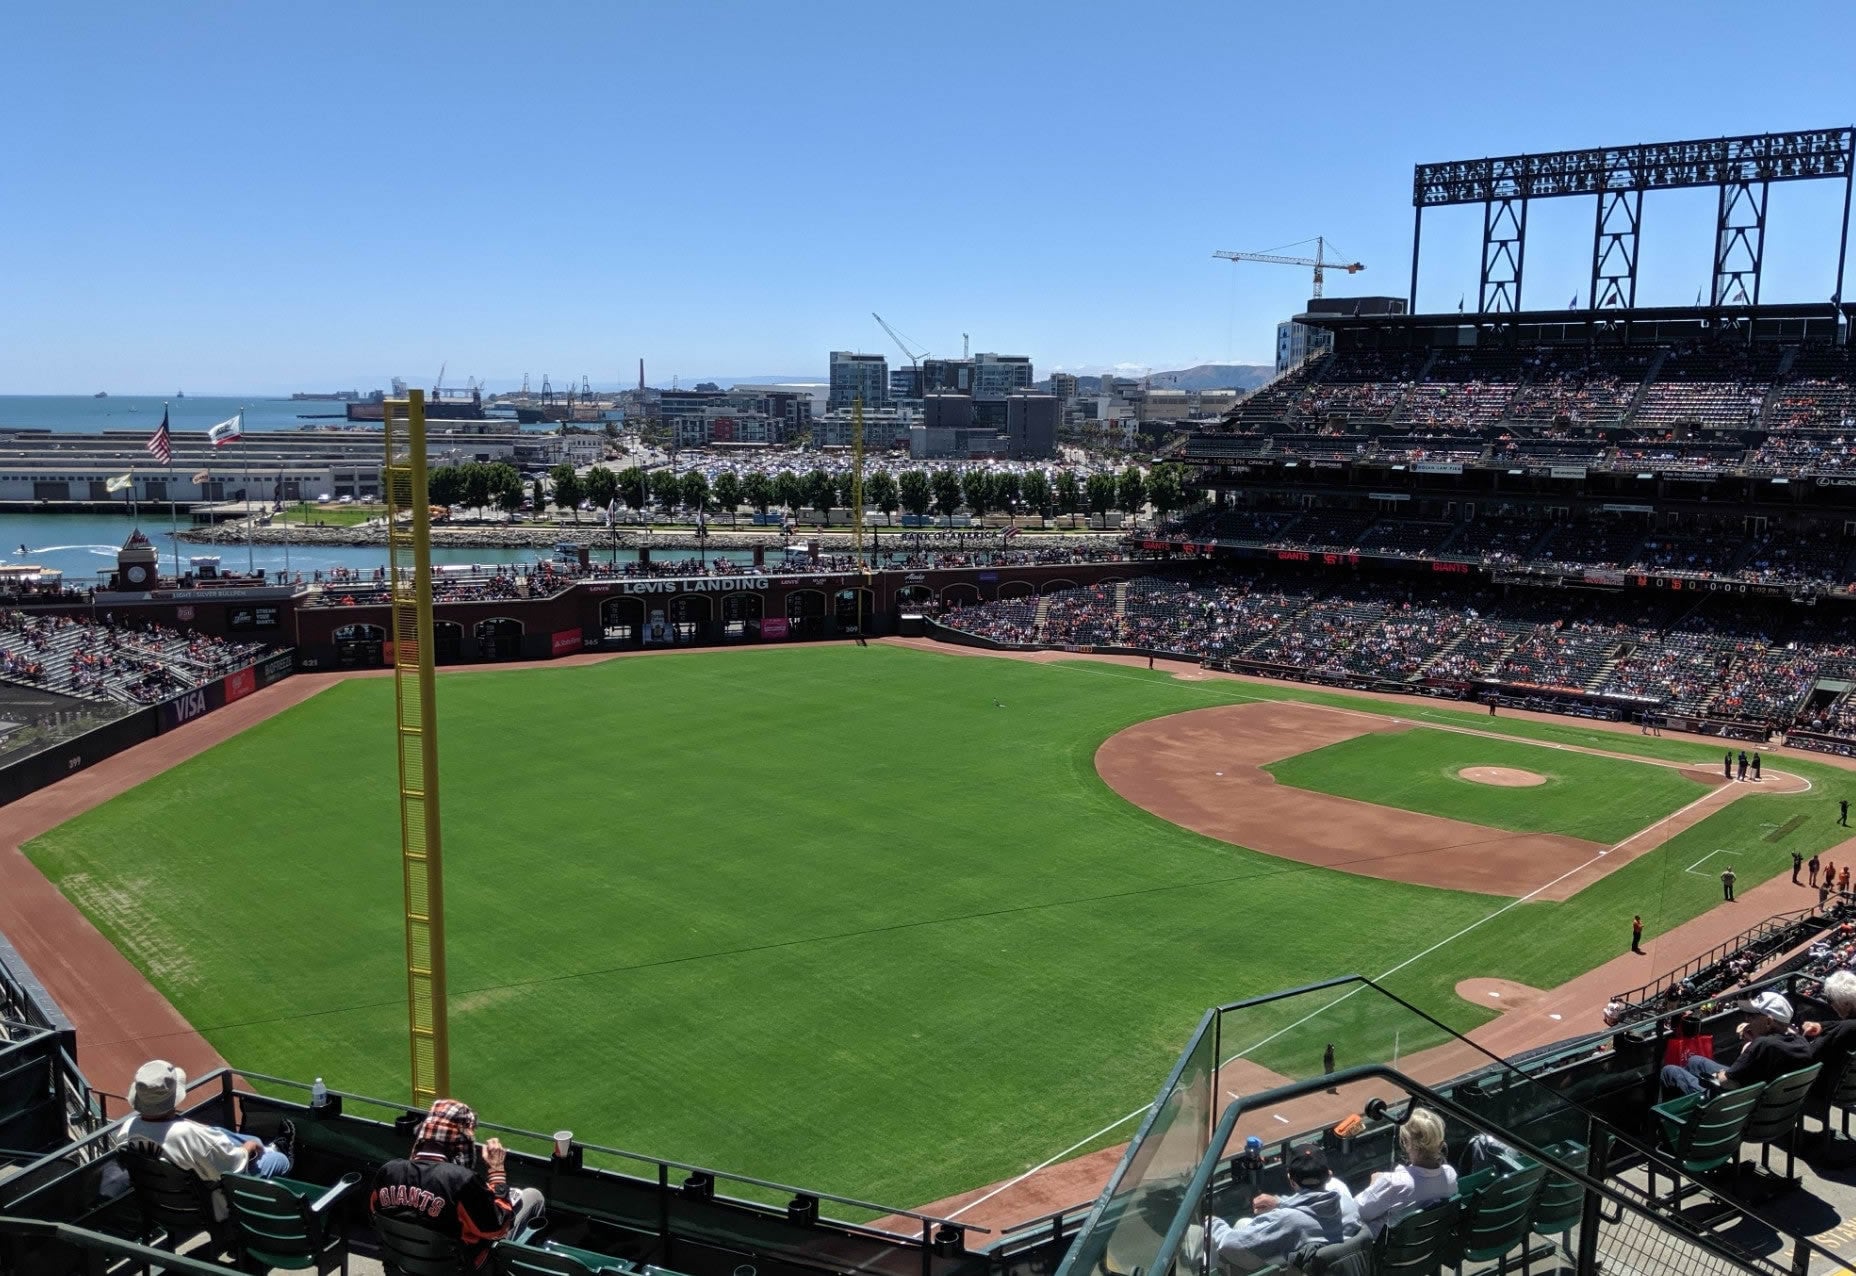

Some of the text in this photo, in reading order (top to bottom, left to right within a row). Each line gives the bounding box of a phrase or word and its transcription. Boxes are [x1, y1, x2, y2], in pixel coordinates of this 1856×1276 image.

[902, 530, 998, 540] BANK OF AMERICA
[1143, 542, 1171, 550] GIANTS
[1278, 551, 1310, 561] GIANTS
[1432, 562, 1468, 573] GIANTS
[683, 579, 768, 592] LANDING
[302, 658, 318, 666] 421
[174, 689, 206, 721] VISA
[68, 756, 81, 769] 399
[379, 1184, 446, 1217] GIANTS
